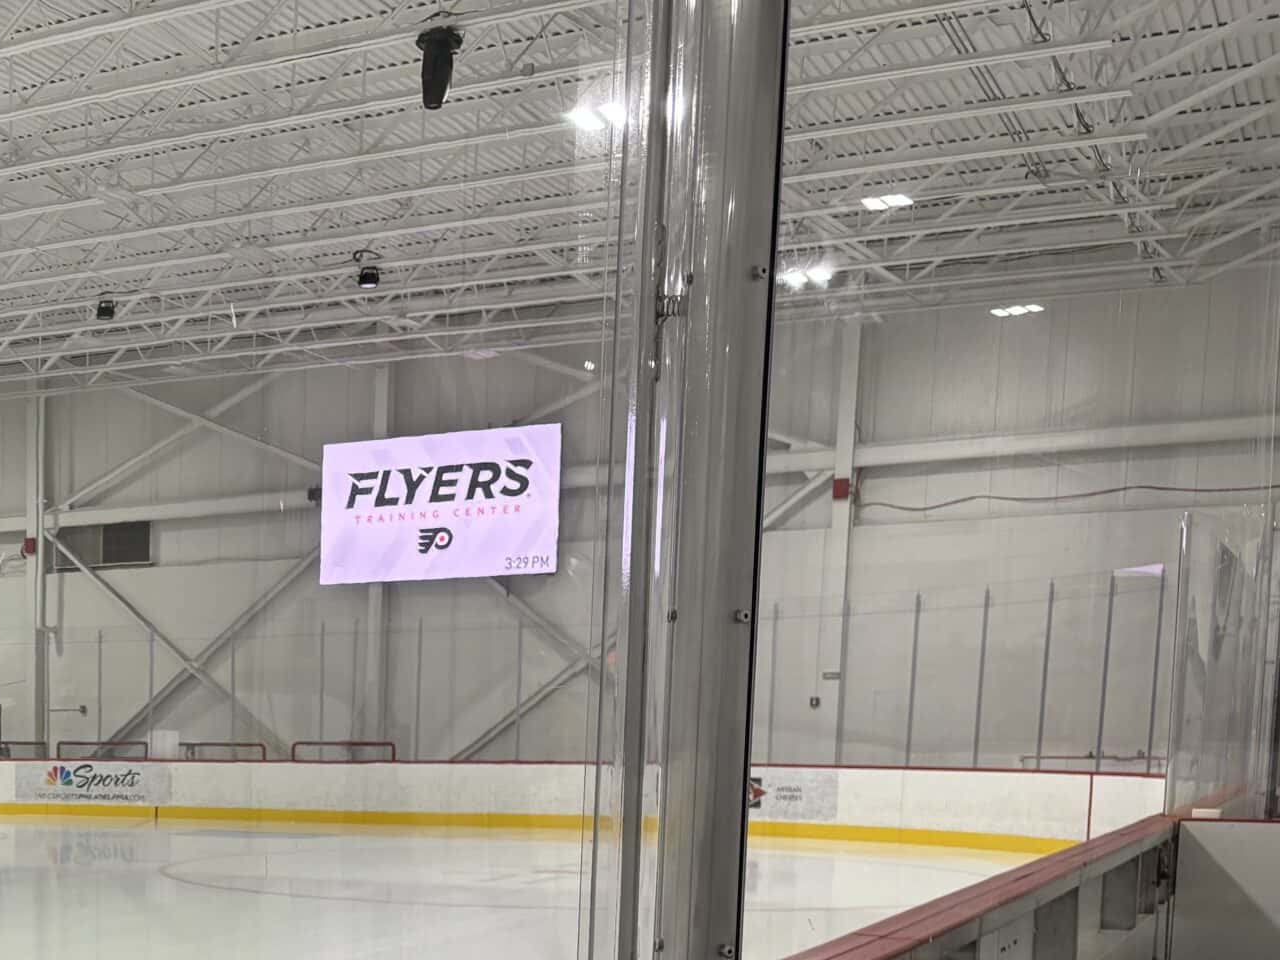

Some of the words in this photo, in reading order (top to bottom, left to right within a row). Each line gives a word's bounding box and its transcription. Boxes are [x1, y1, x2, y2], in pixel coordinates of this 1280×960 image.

[346, 459, 533, 509] FLYERS
[355, 511, 440, 524] TRAINING
[453, 504, 521, 518] CENTER
[505, 556, 529, 570] 3:29
[531, 555, 550, 568] PM
[73, 764, 141, 792] Sports
